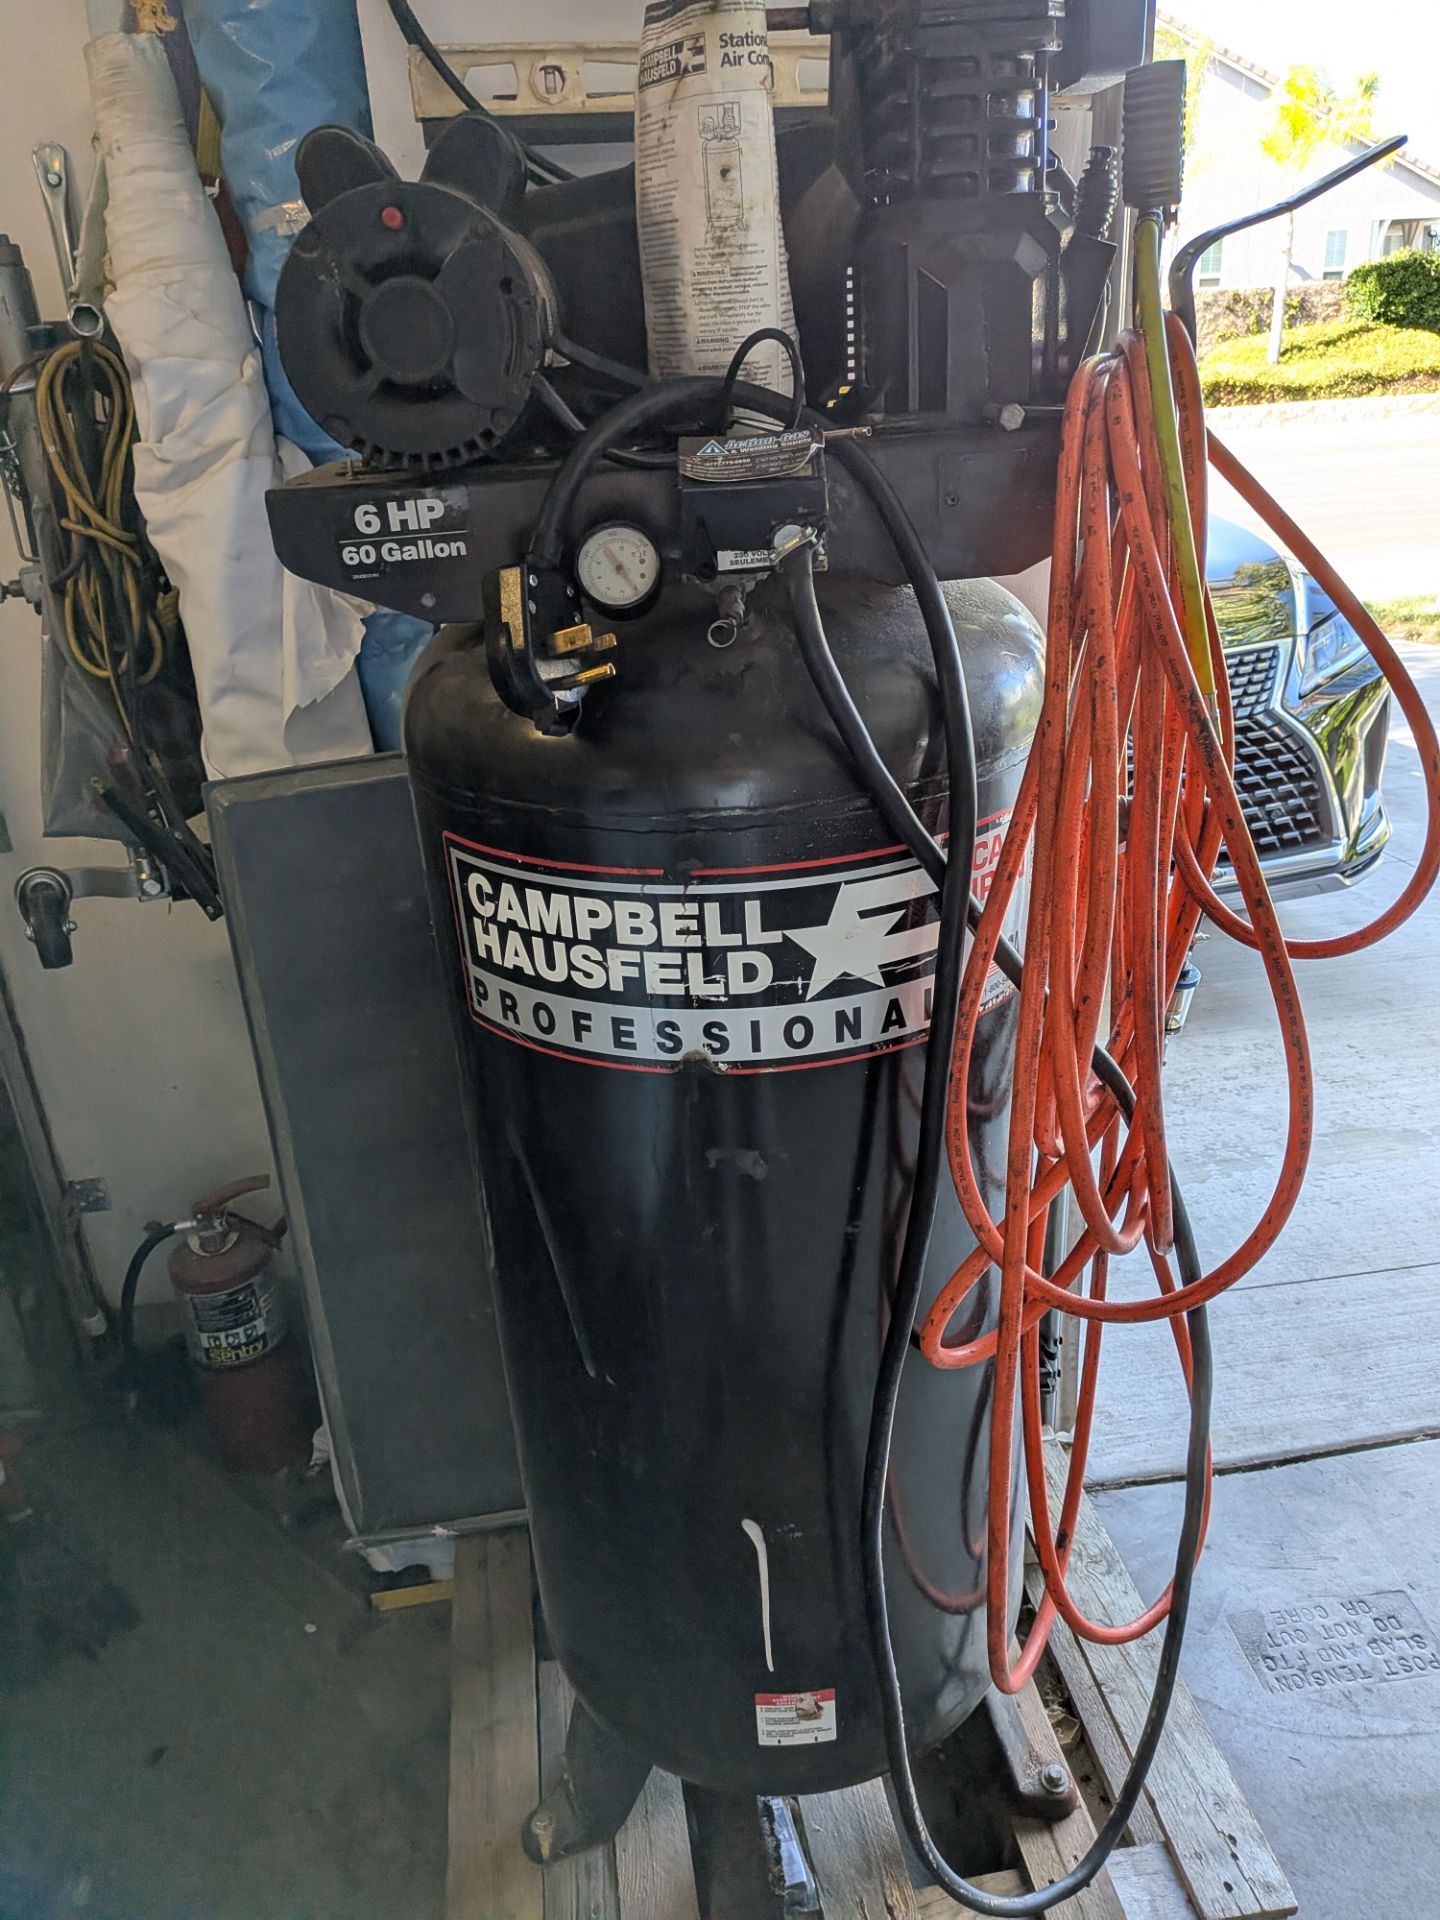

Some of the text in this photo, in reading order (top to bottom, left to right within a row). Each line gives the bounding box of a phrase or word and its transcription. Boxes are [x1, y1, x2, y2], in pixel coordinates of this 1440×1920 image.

[640, 44, 678, 71] CAMPBELL
[720, 51, 745, 68] Air
[697, 269, 726, 277] WARNING
[701, 337, 730, 345] WARNING
[354, 498, 445, 535] 6 HP
[342, 539, 467, 566] 60 Gallon
[729, 558, 769, 566] SEULEME
[466, 872, 783, 946] CAMPBELL
[474, 916, 775, 998] HAUSFELD
[208, 1339, 263, 1362] sentry
[1270, 1600, 1371, 1626] OR CORE
[1267, 1615, 1404, 1648] DO NOT CUT
[1367, 1633, 1427, 1655] SLAB
[1316, 1642, 1361, 1663] AND
[1273, 1652, 1440, 1693] POST TENSION
